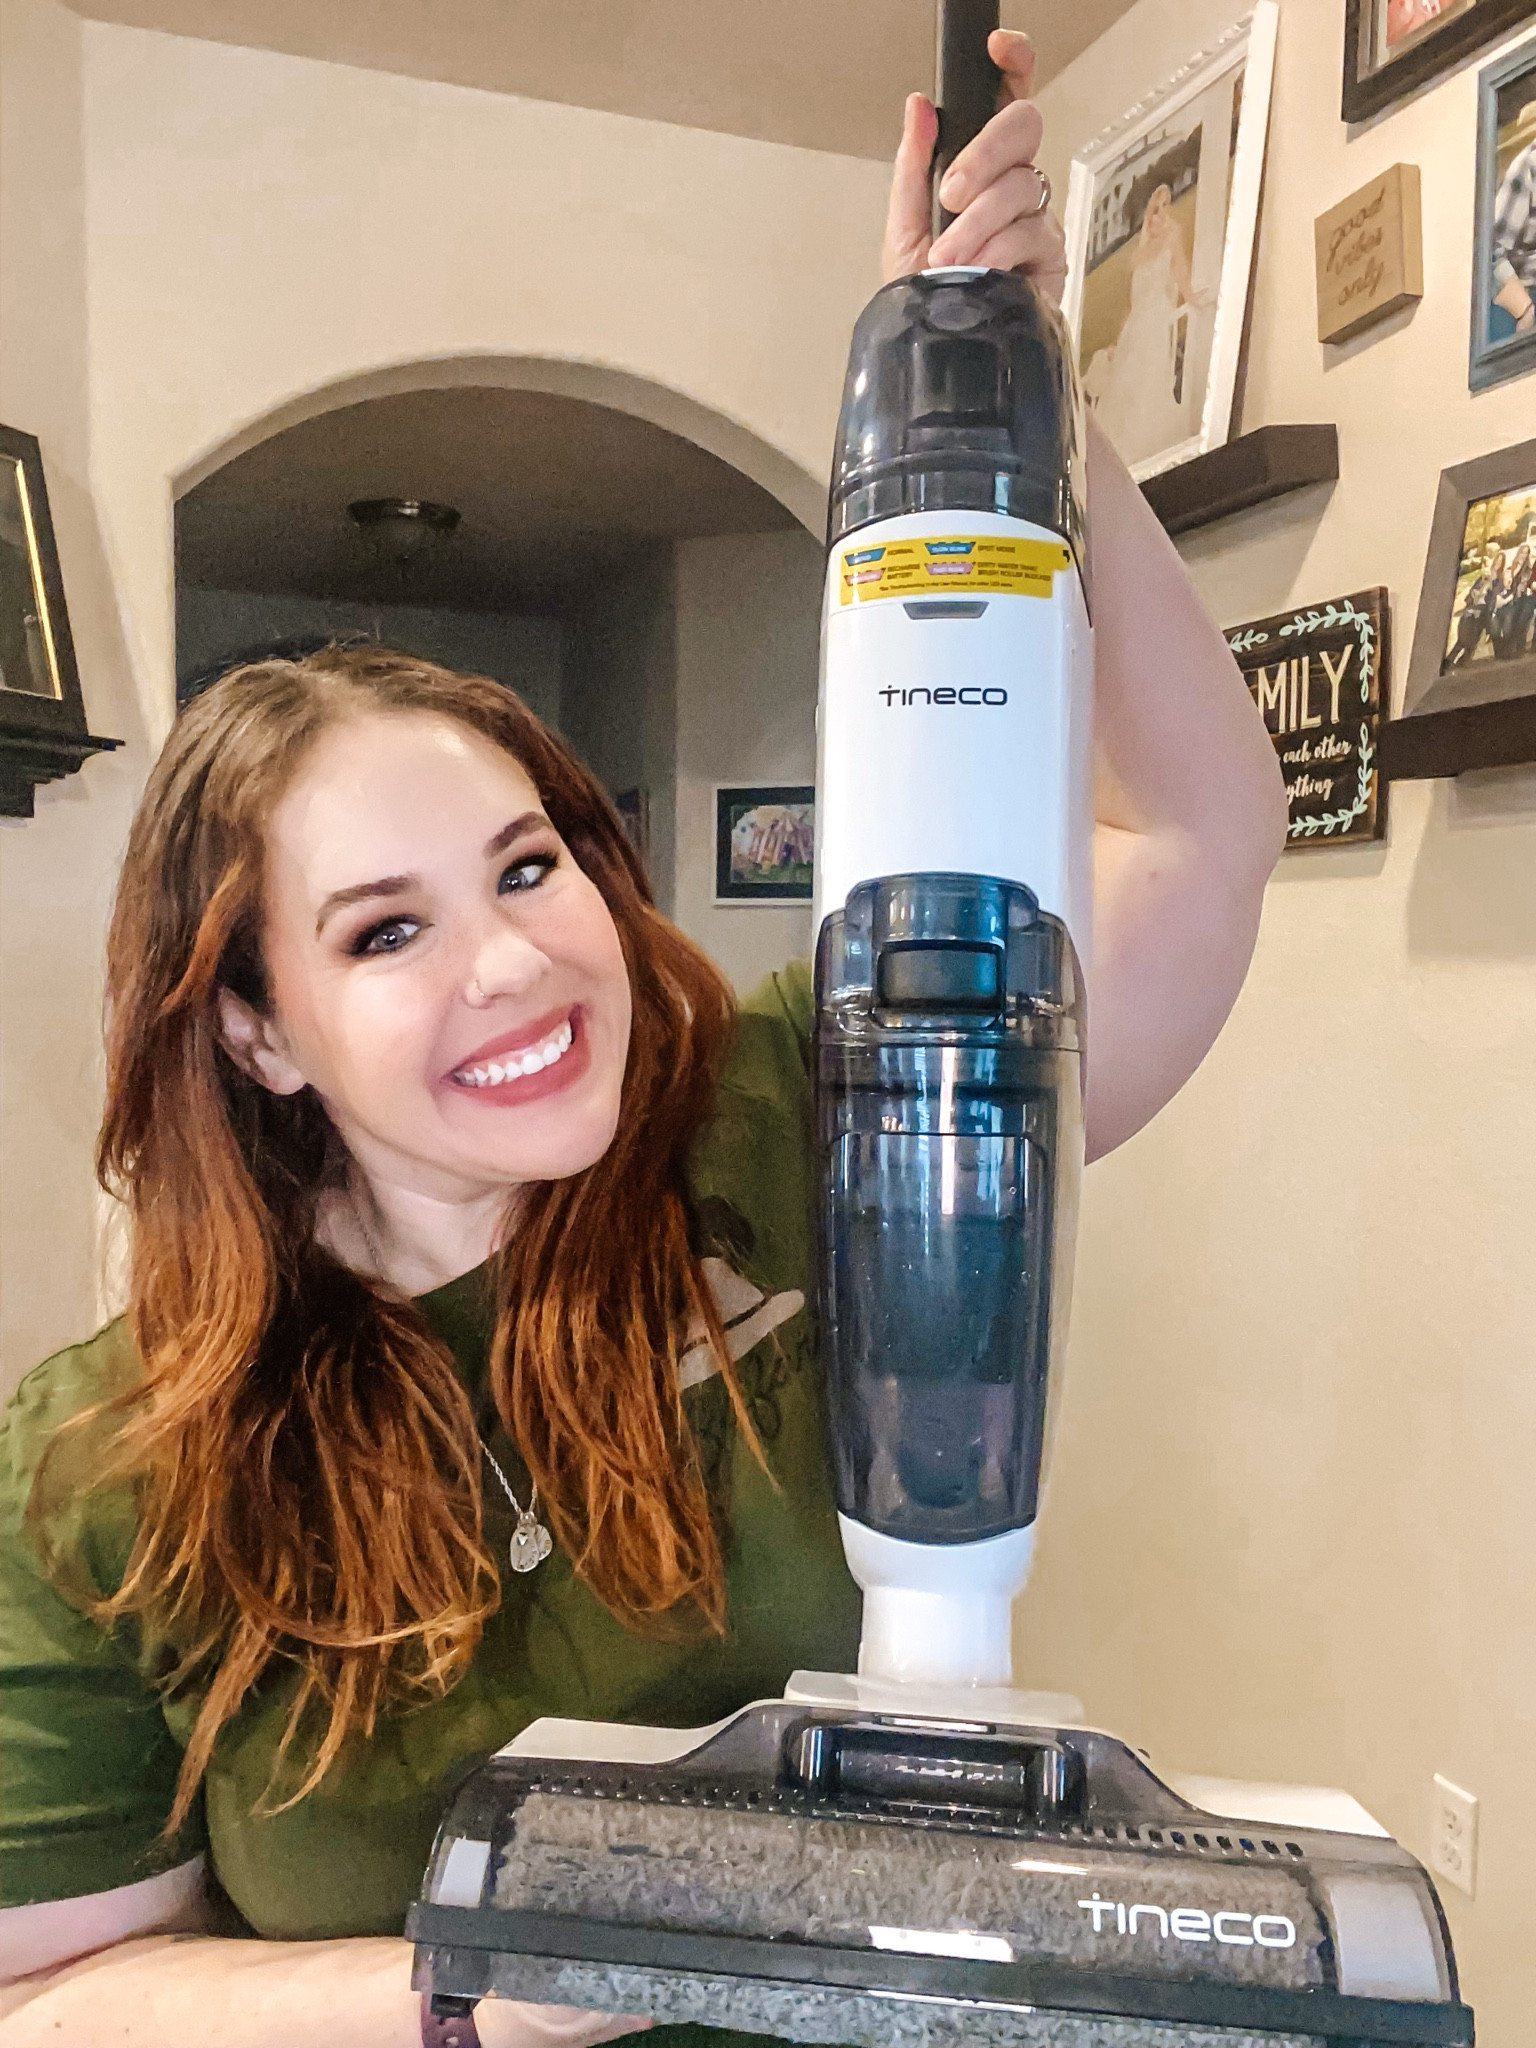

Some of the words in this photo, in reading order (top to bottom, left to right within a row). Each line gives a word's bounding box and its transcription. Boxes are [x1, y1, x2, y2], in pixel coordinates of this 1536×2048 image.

[1326, 186, 1386, 273] good
[1335, 226, 1383, 276] vibes
[1338, 256, 1385, 306] only
[1283, 740, 1312, 764] each
[1314, 733, 1352, 759] other
